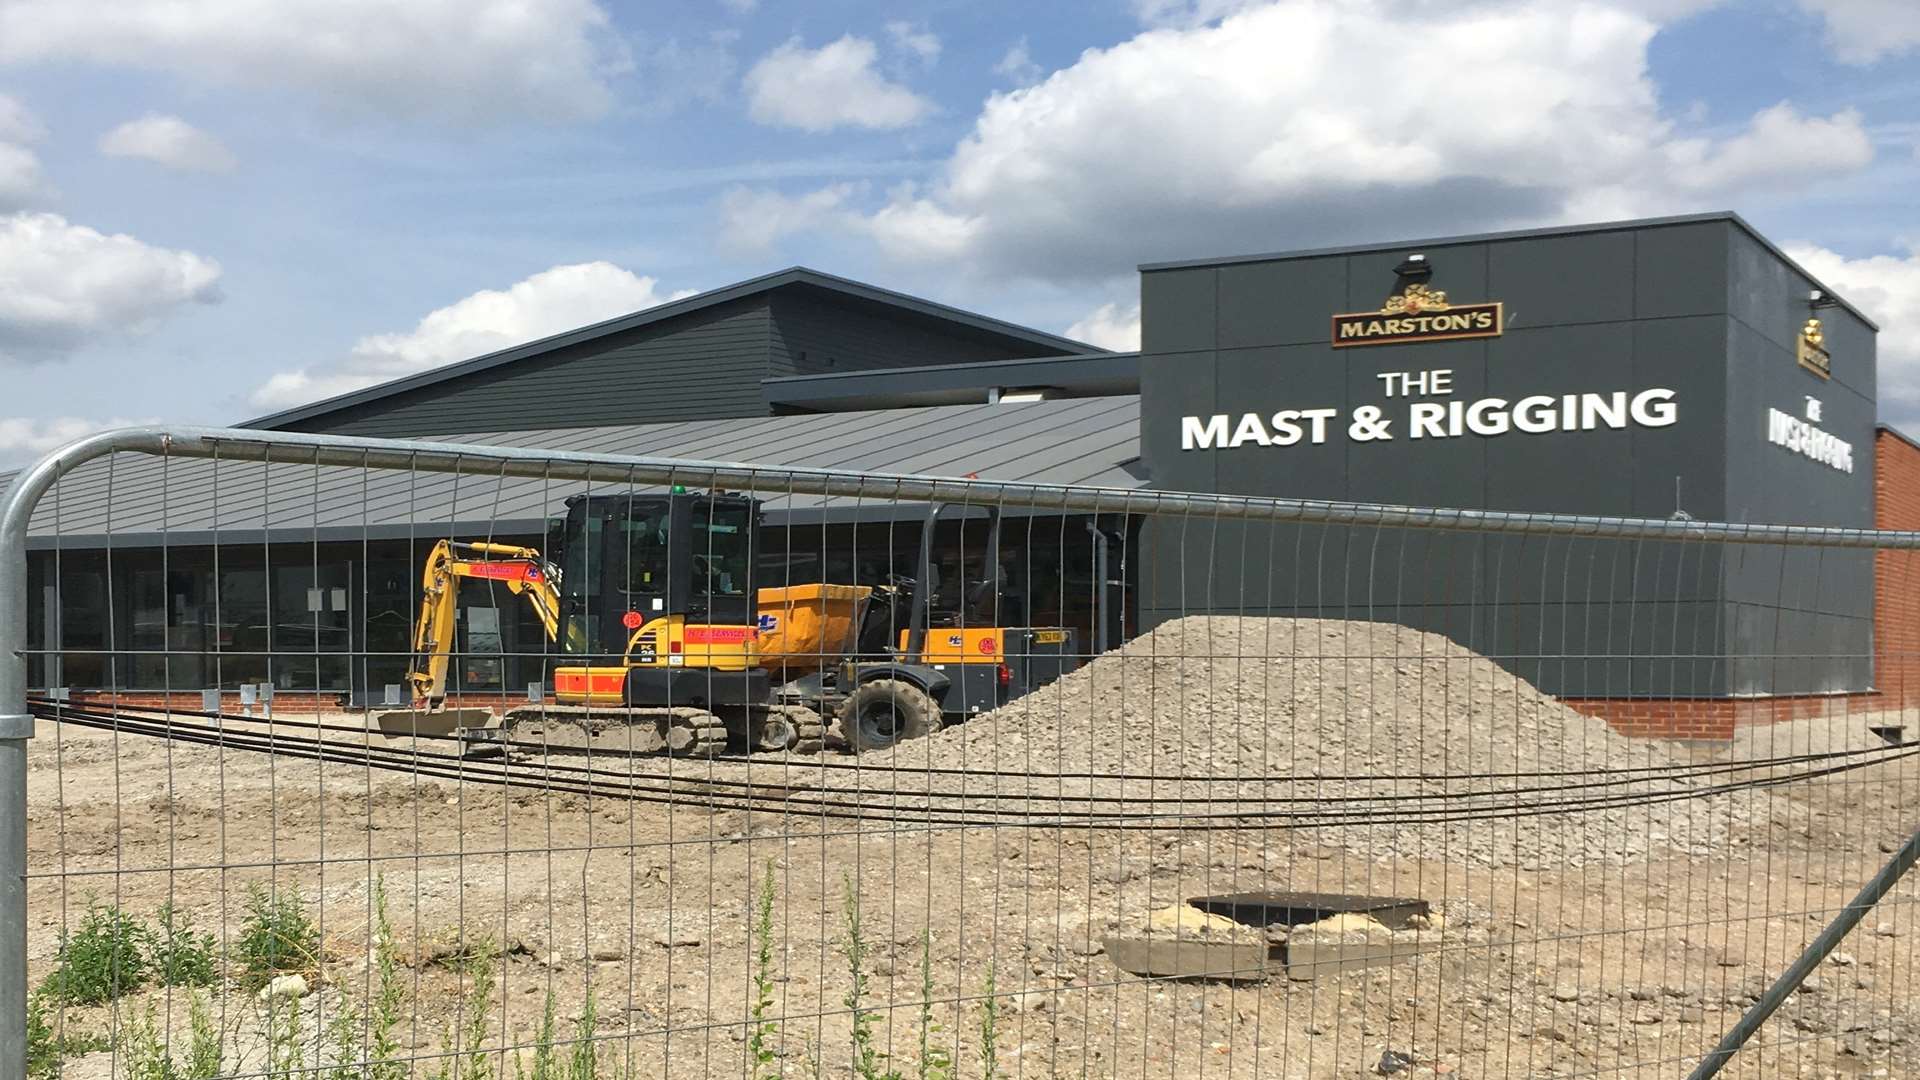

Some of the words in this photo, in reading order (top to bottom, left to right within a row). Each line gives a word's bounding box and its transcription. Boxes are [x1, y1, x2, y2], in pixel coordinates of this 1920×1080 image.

[1340, 311, 1492, 338] MARSTON'S
[1377, 369, 1453, 397] THE
[1181, 408, 1337, 450] MAST
[1348, 405, 1393, 441] &
[1410, 388, 1677, 438] RIGGING
